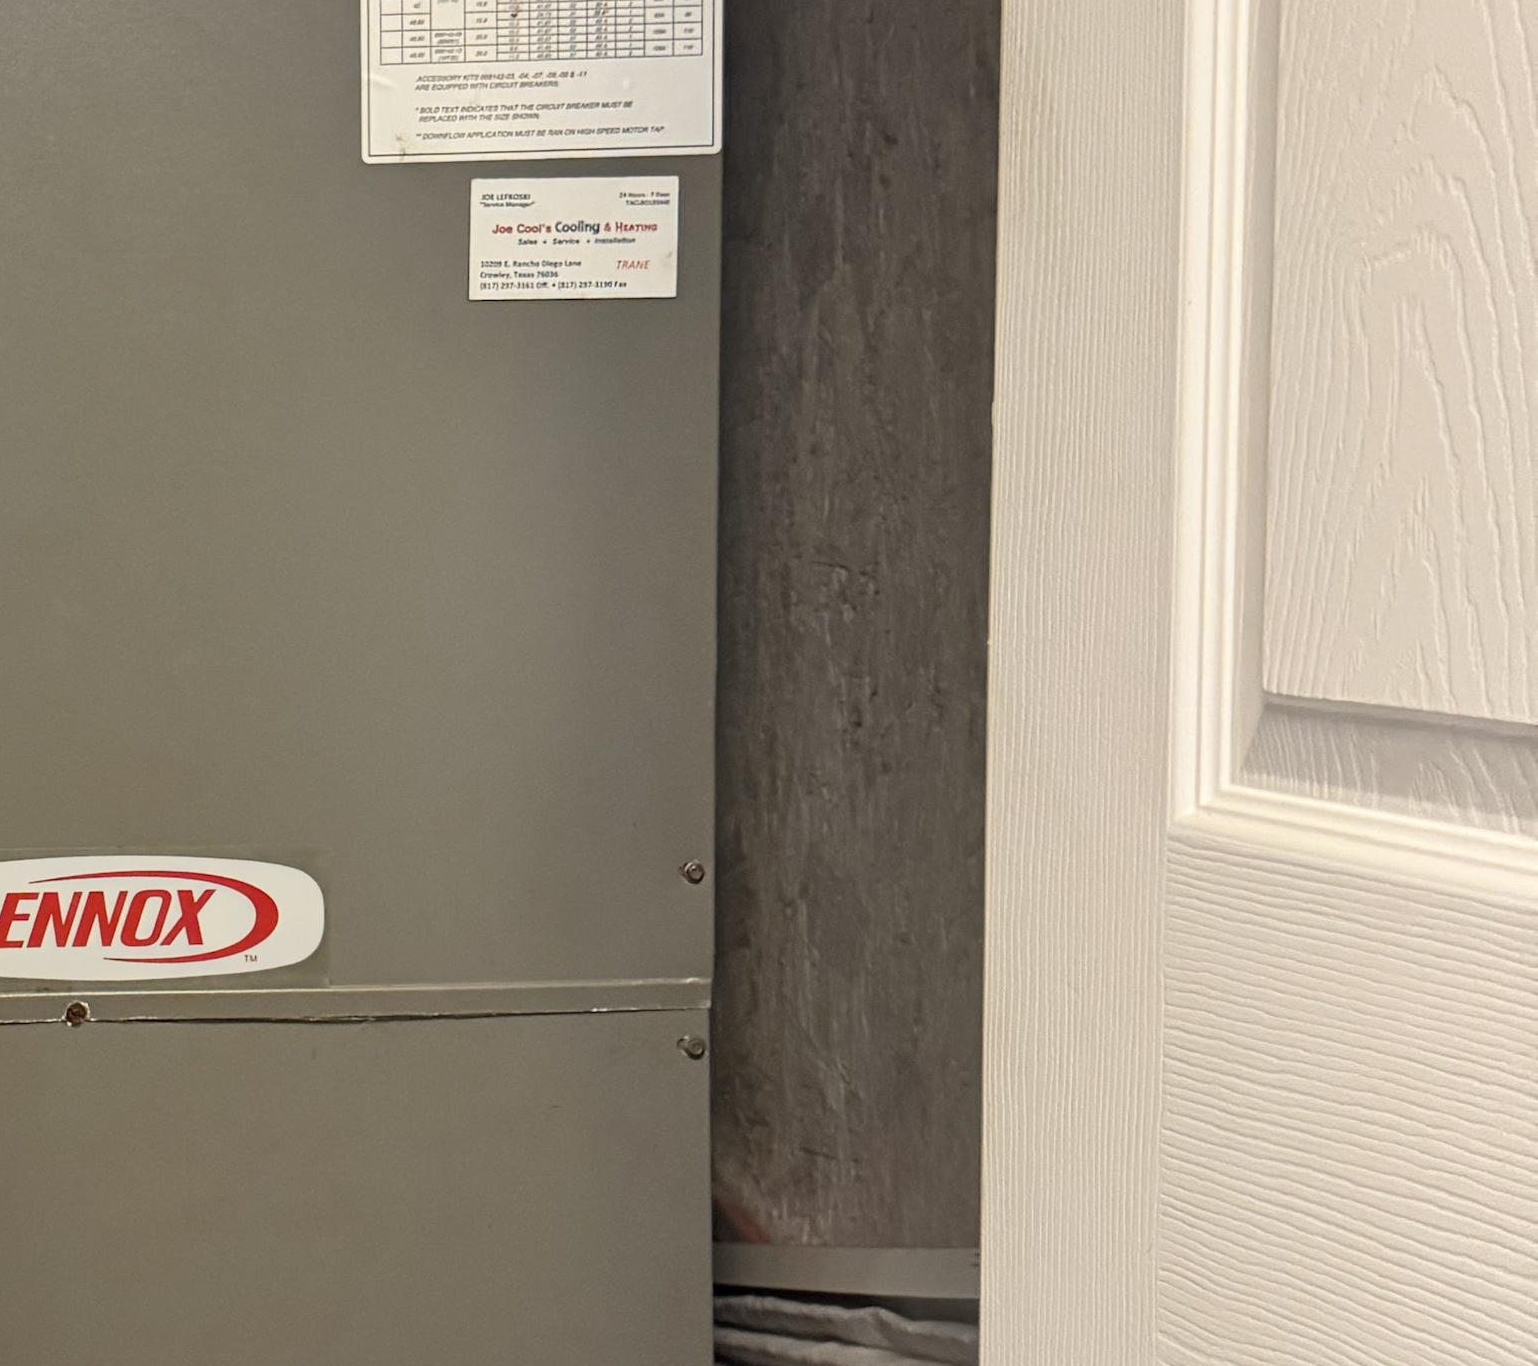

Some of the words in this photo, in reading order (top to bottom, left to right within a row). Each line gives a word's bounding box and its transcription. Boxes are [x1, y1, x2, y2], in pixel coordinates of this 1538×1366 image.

[492, 225, 512, 233] Joe
[516, 223, 551, 233] Cool's
[554, 220, 600, 233] Cooling
[615, 223, 657, 231] HEATING
[616, 259, 649, 269] TRANE
